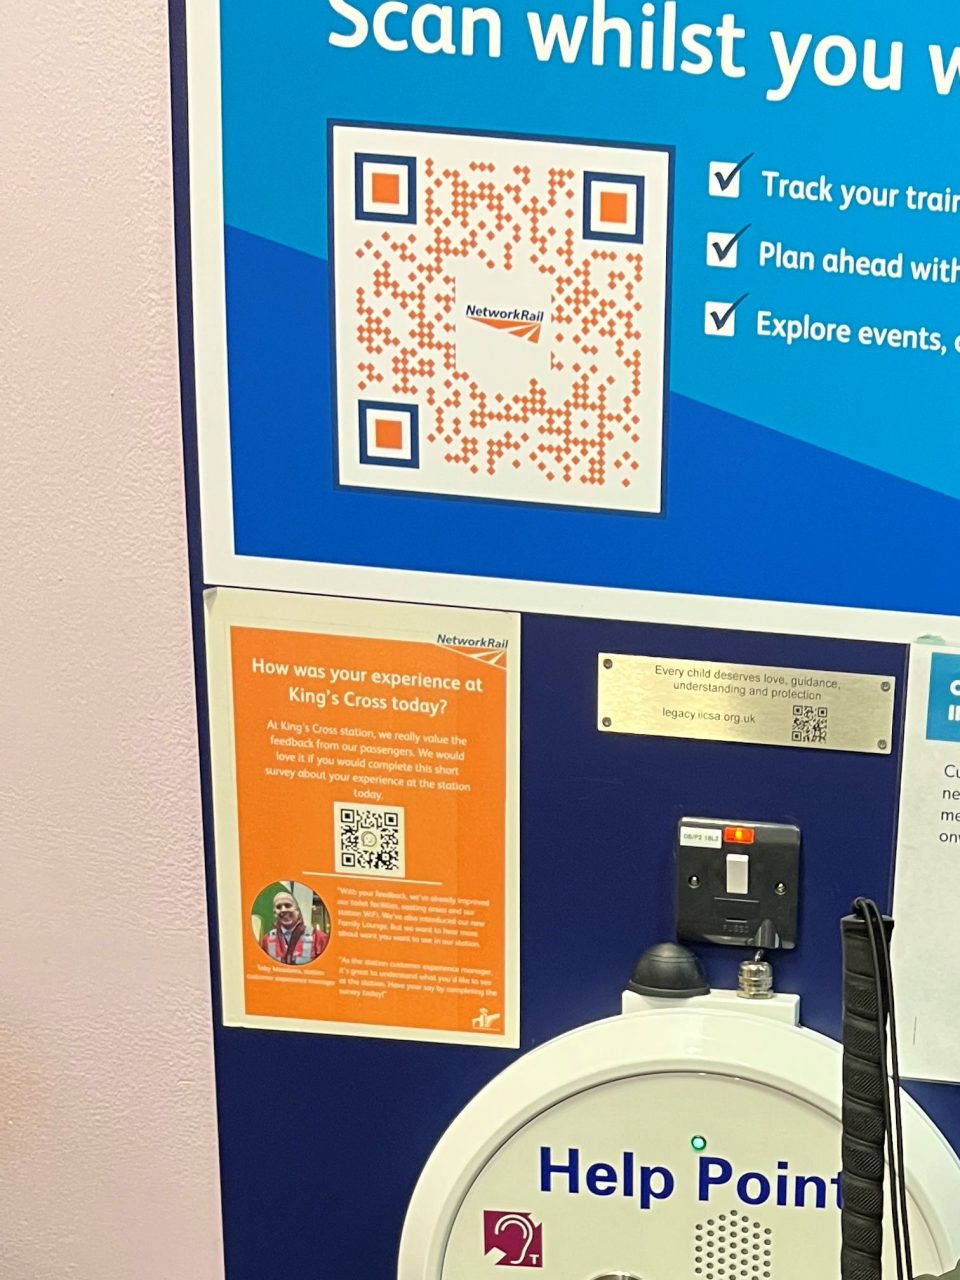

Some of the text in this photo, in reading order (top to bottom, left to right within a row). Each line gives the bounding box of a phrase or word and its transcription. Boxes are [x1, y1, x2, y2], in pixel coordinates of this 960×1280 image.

[328, 0, 501, 58] Scan
[526, 0, 746, 79] whilst
[766, 31, 904, 102] you
[762, 170, 833, 202] Track
[839, 183, 899, 210] your
[759, 241, 815, 271] Plan
[822, 248, 903, 278] ahead
[466, 304, 544, 322] NetworkRail
[756, 310, 850, 345] Explore
[858, 324, 947, 356] events,
[436, 634, 508, 649] NetworkRail
[252, 657, 483, 692] How was your experience at
[655, 665, 841, 690] Every child deserves love, guidance,
[673, 680, 821, 701] understanding and protection
[344, 691, 387, 710] Cross
[391, 695, 448, 717] today?
[267, 720, 279, 729] At
[312, 724, 338, 735] Cross
[340, 728, 376, 739] station,
[379, 731, 392, 740] we
[395, 731, 420, 744] really
[423, 734, 448, 744] value
[451, 735, 467, 746] the
[270, 735, 465, 761] feedback from our passengers. We would
[277, 751, 459, 776] love it if you would complete this short
[265, 767, 471, 792] survey about your experience at the station
[354, 788, 383, 800] today.
[540, 1146, 675, 1210] Help
